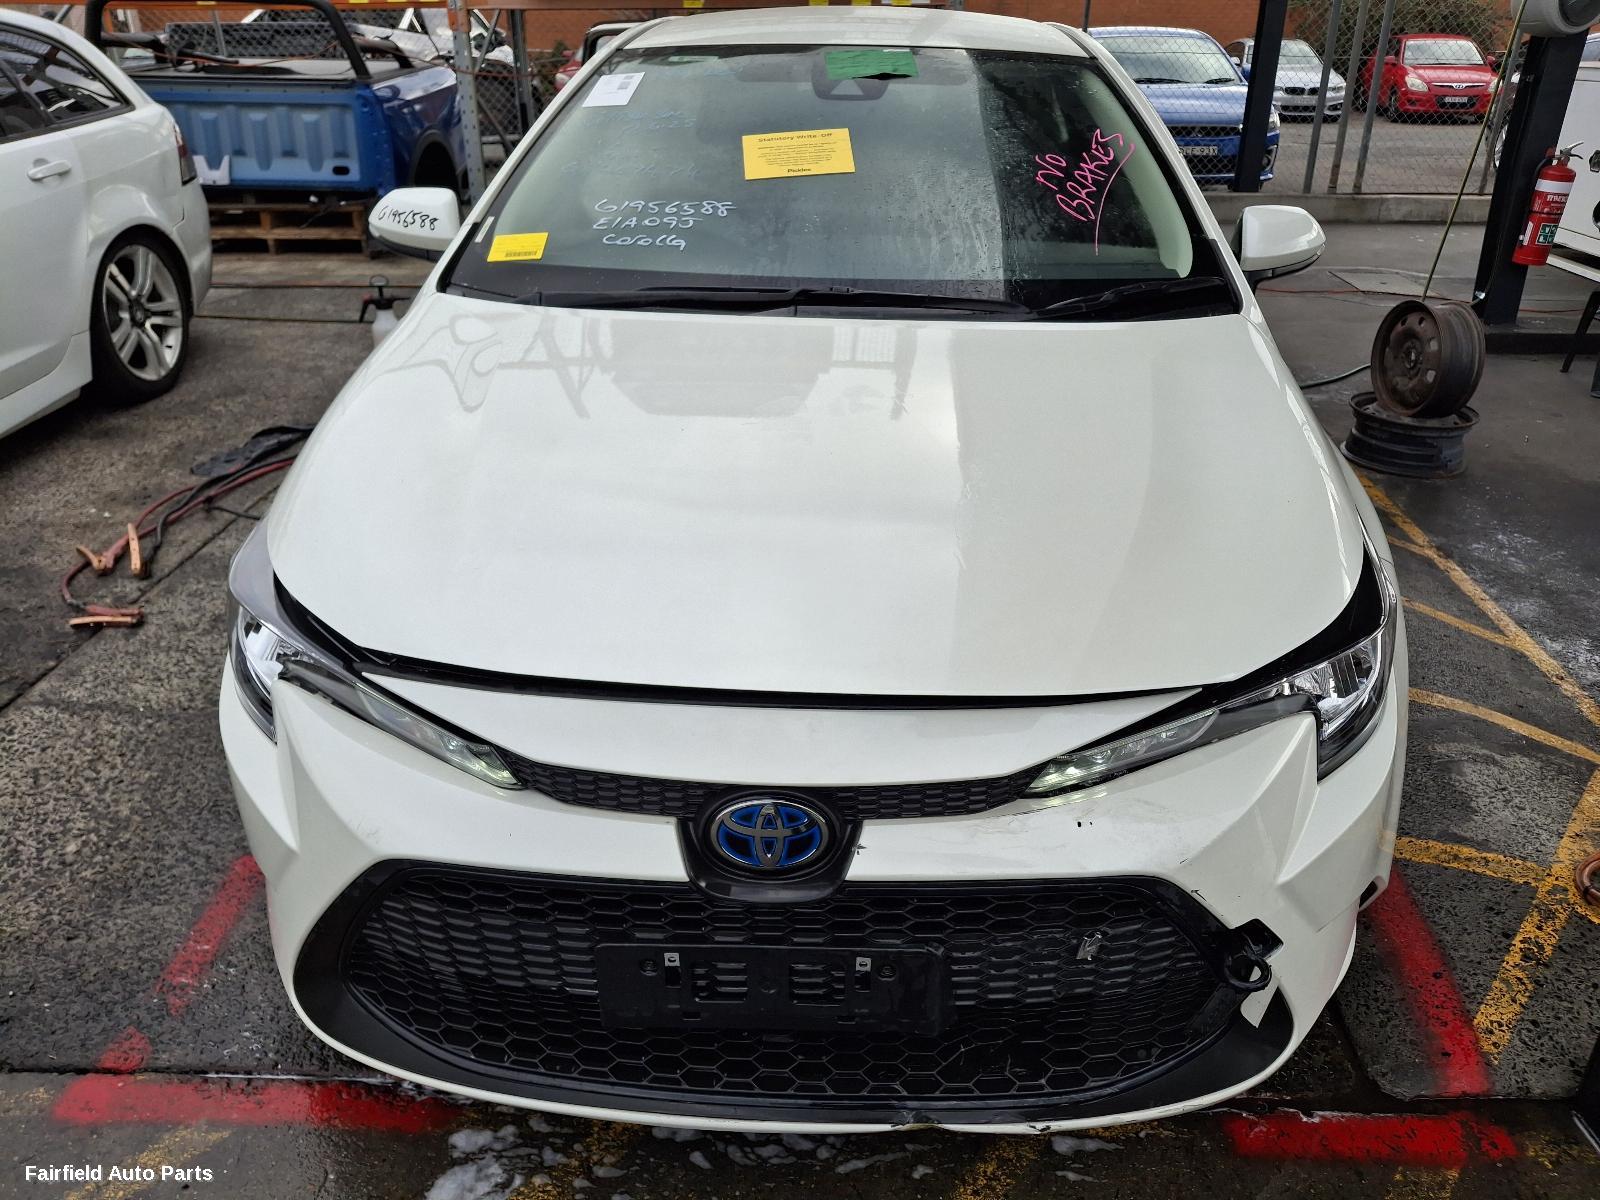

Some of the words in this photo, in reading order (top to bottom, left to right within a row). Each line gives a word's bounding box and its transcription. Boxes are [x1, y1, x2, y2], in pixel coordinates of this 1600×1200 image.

[1056, 128, 1124, 221] BRAKES
[378, 205, 439, 230] 61956588
[594, 198, 738, 216] 61956588
